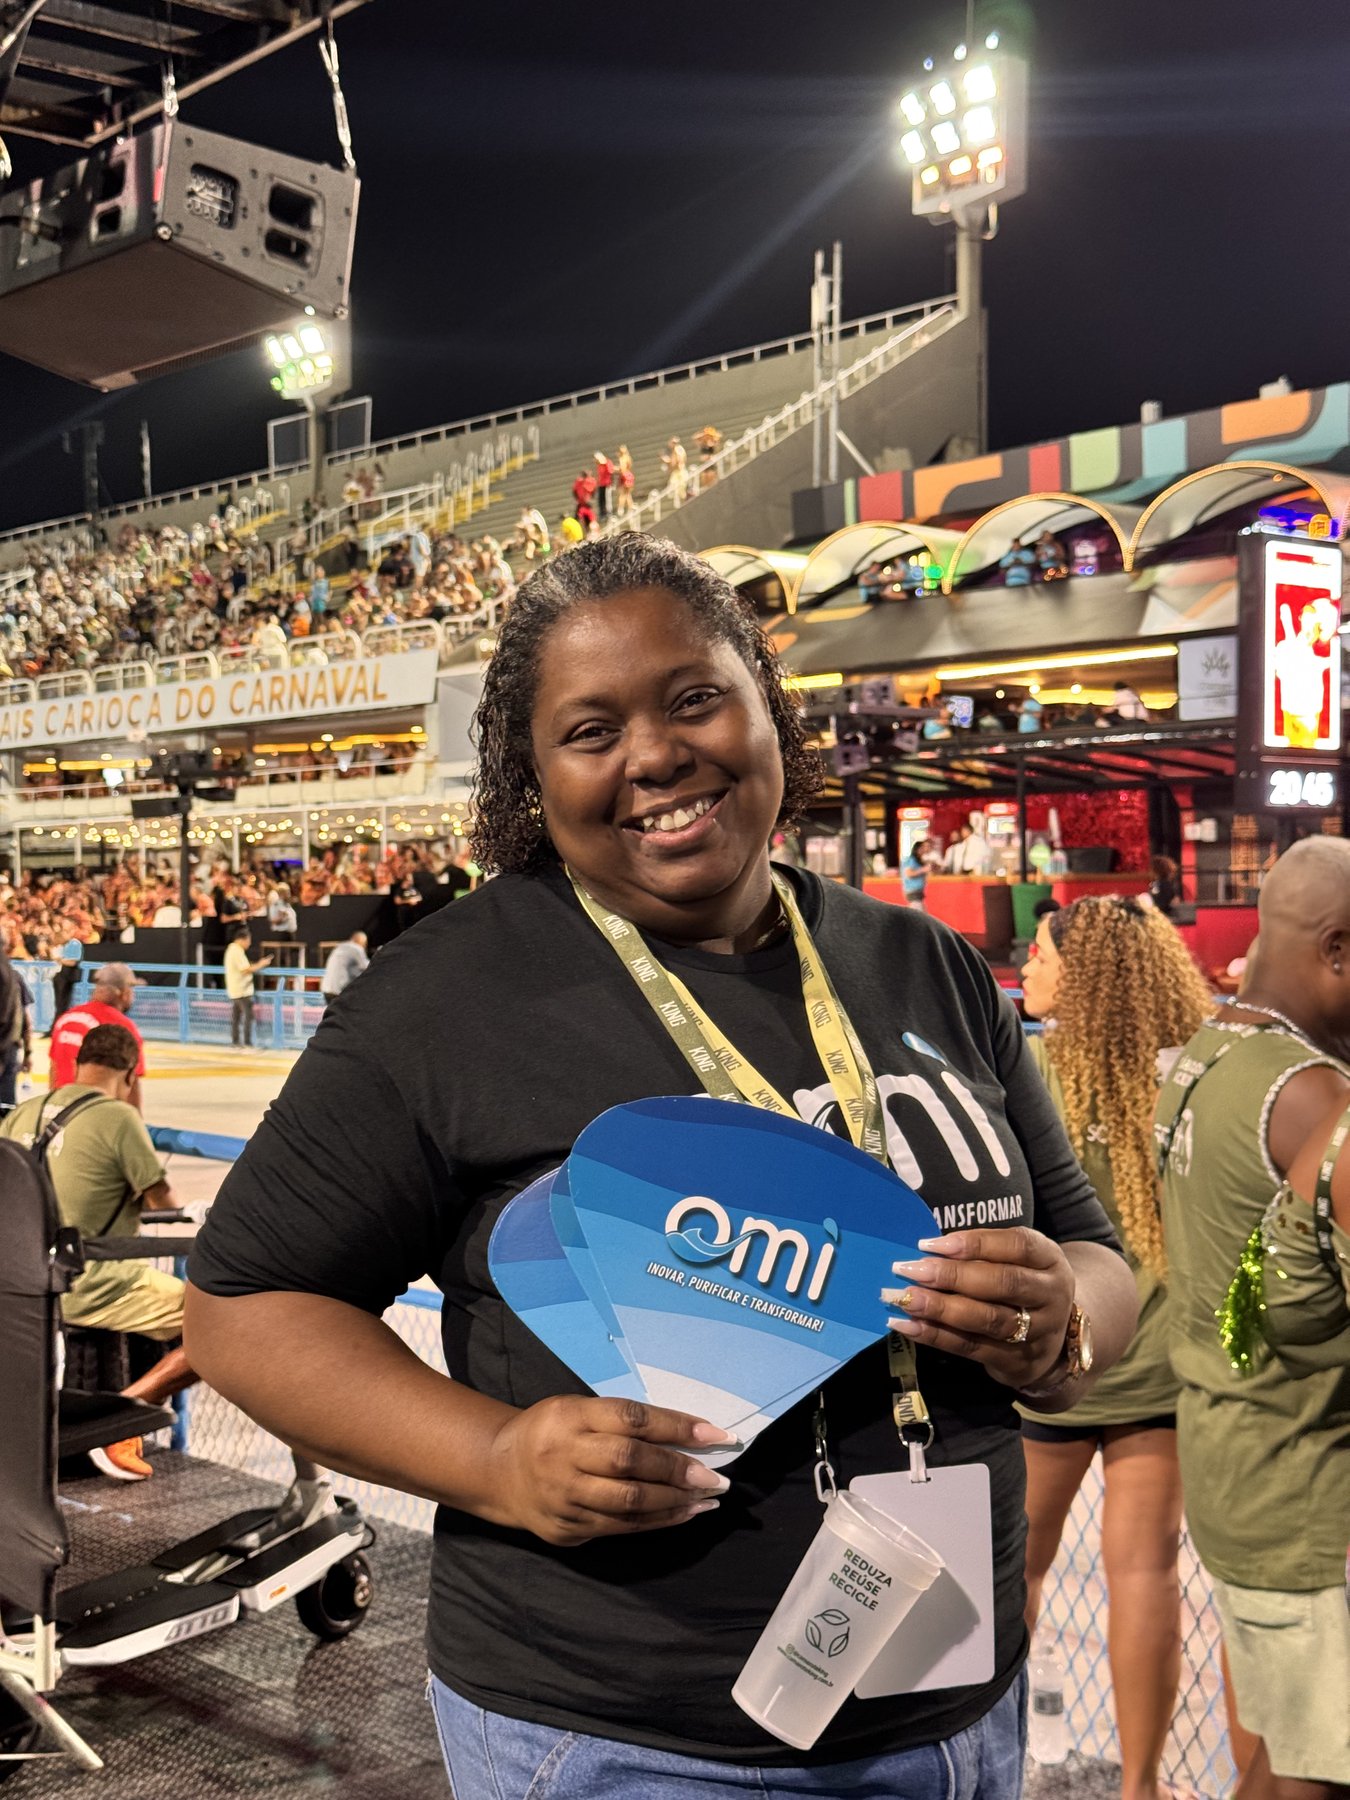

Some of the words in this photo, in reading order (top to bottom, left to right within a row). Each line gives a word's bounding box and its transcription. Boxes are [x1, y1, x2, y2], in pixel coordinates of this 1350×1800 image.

[44, 691, 162, 736] CARIOCA
[176, 685, 215, 722] DO
[229, 662, 388, 716] CARNAVAL
[602, 914, 630, 940] KING
[631, 956, 658, 983] KING
[659, 1000, 687, 1028] KING
[811, 1001, 832, 1029] KING
[688, 1046, 717, 1073] KING
[714, 1046, 742, 1072] KING
[825, 1049, 849, 1075] KING
[864, 1074, 878, 1105] KING
[865, 1127, 883, 1155] KING
[933, 1194, 1024, 1230] ANSFORMAR
[647, 1262, 687, 1287] INOVAR,
[688, 1276, 741, 1303] PURIFICAR
[741, 1295, 749, 1307] E
[750, 1297, 825, 1333] TRANSFORMAR!
[897, 1395, 917, 1424] KING
[841, 1564, 881, 1595] REÚSE
[844, 1549, 892, 1587] REDUZA
[828, 1572, 878, 1610] RECICLE
